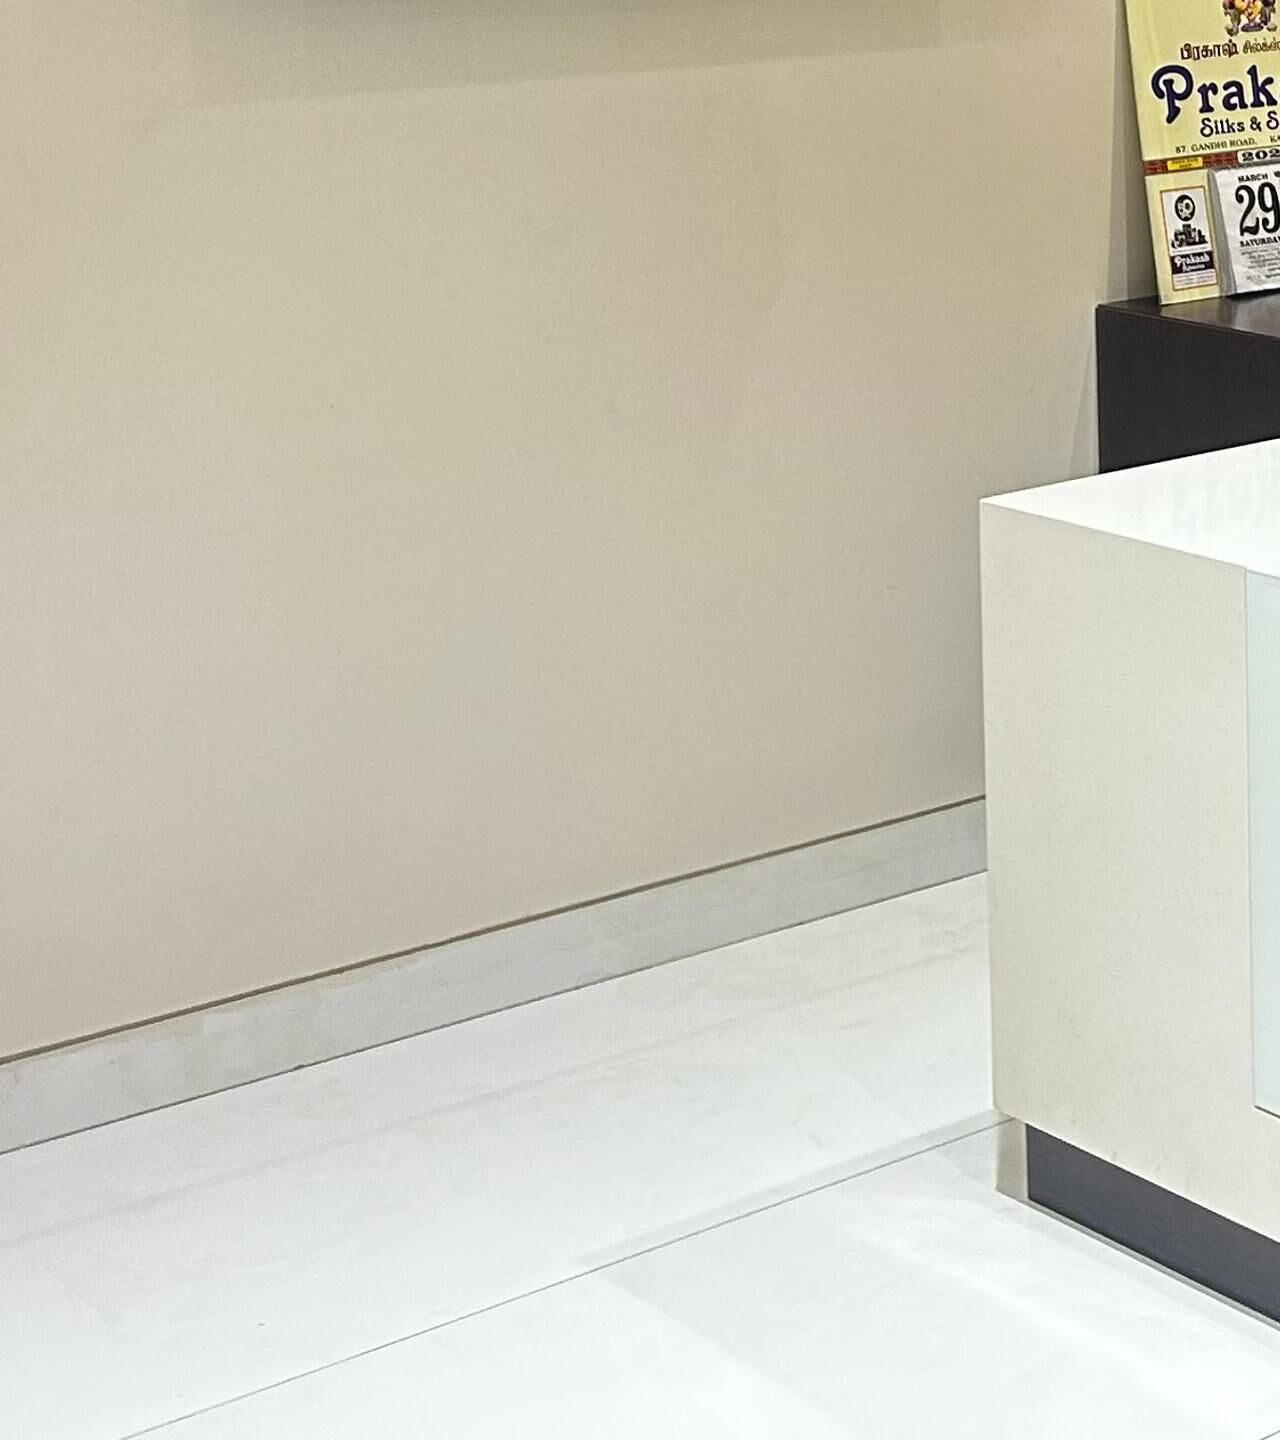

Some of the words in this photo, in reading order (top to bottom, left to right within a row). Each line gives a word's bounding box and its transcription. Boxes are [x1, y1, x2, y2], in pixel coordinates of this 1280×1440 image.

[1180, 39, 1239, 61] பிரகாஷ்
[1200, 116, 1245, 138] Silks
[1249, 116, 1262, 132] &
[1191, 140, 1228, 153] GANDHI
[1238, 173, 1268, 183] MARCH
